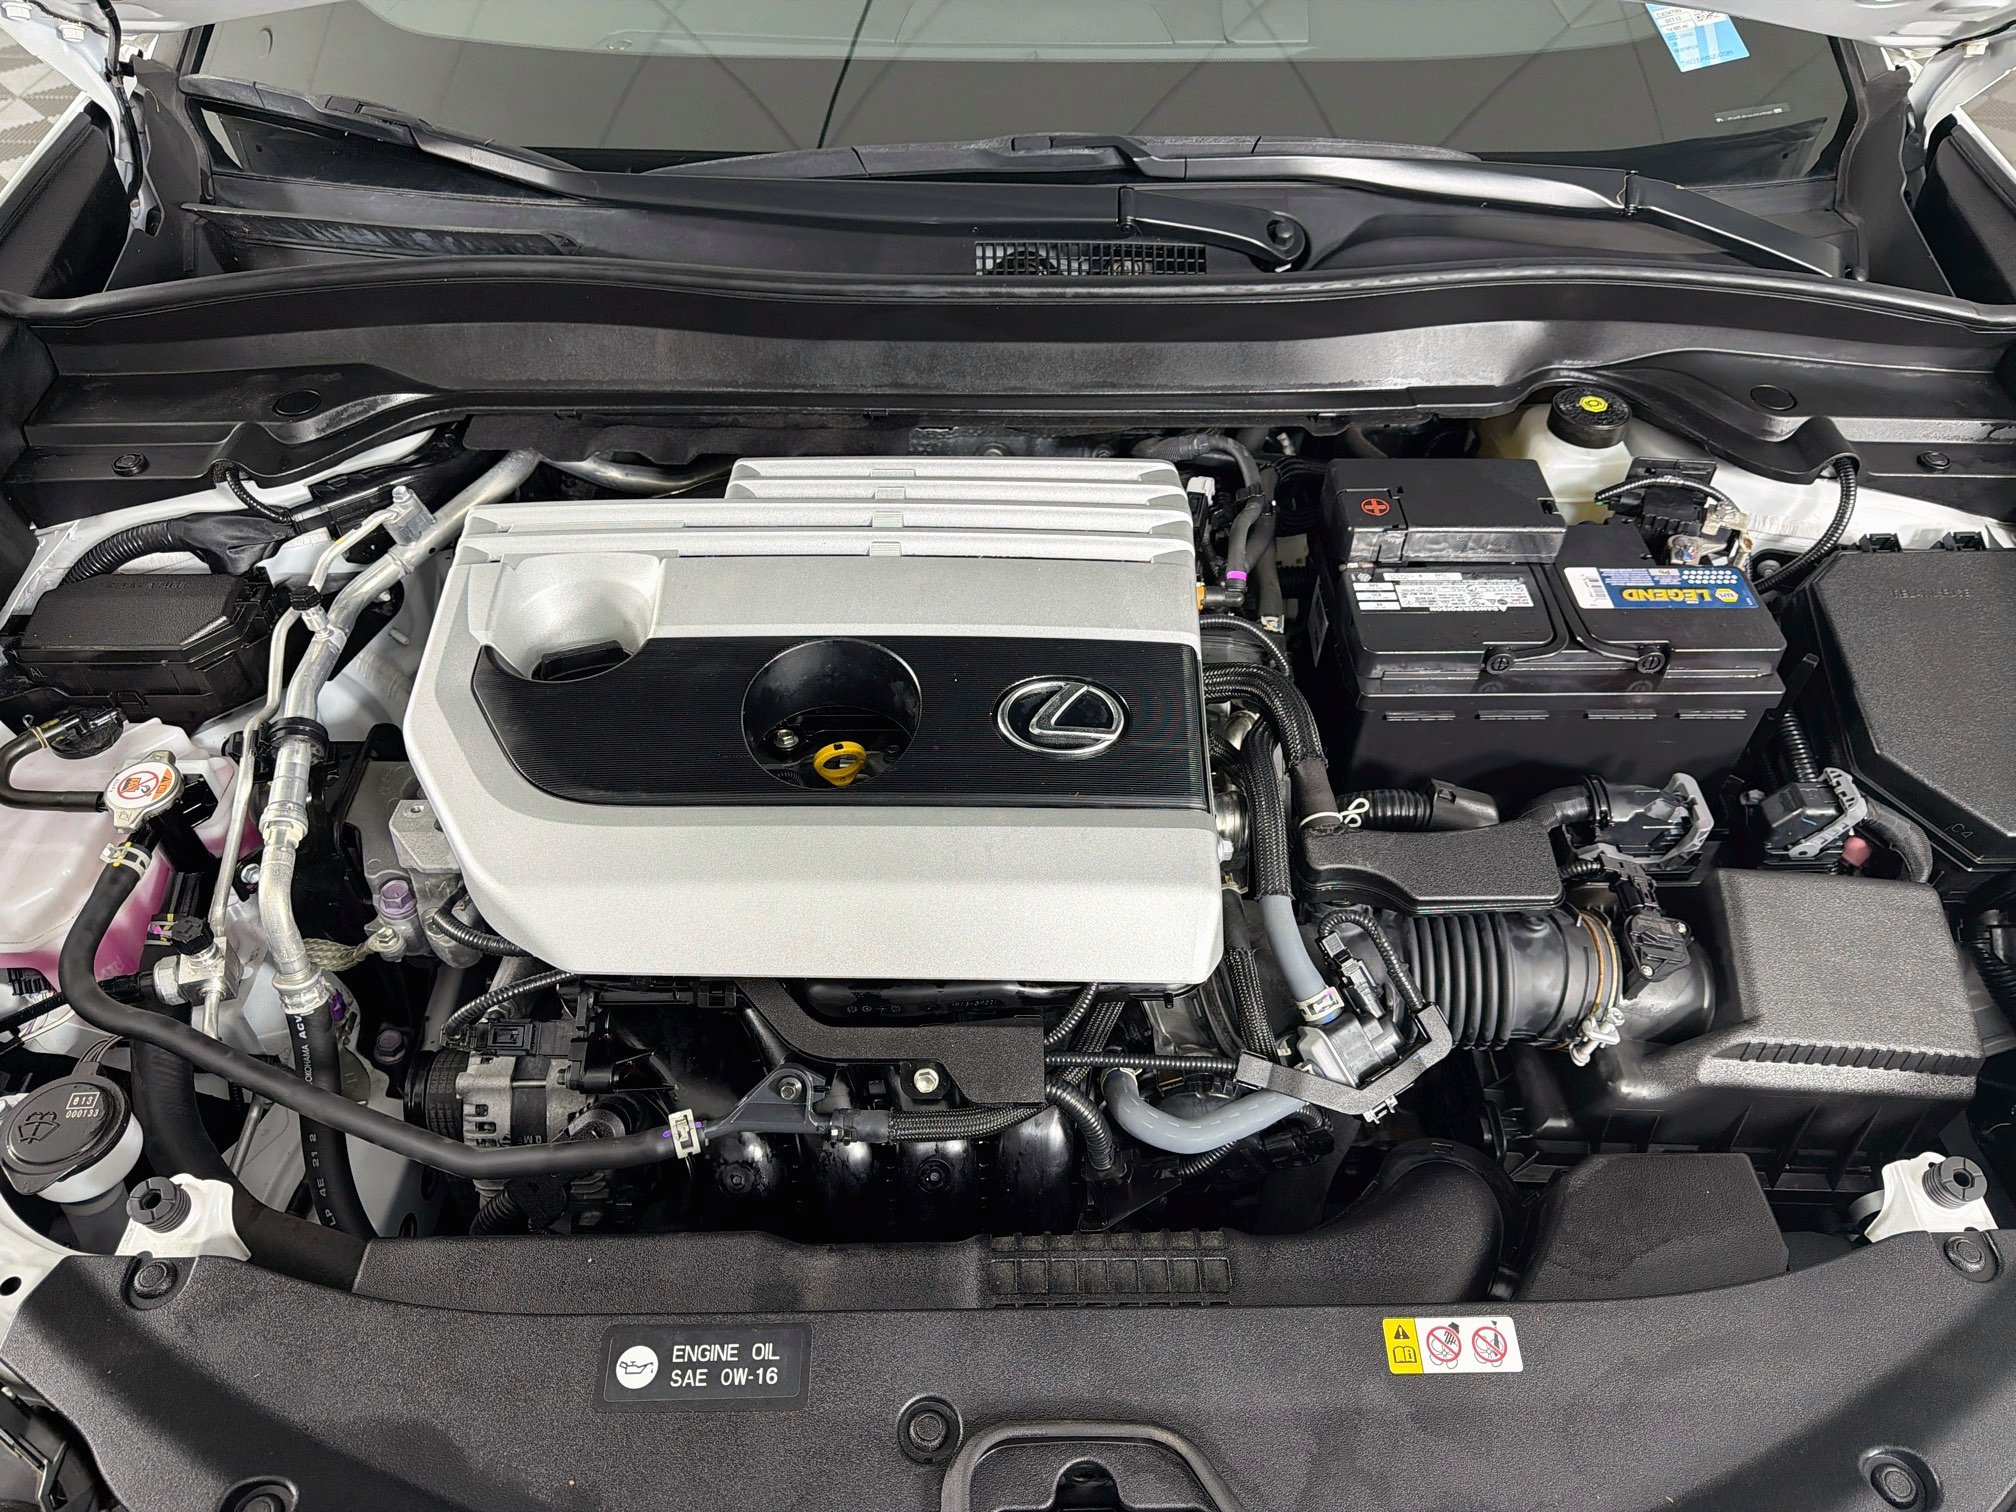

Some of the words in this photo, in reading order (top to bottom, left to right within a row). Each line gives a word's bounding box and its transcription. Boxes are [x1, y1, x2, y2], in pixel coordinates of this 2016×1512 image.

[1622, 588, 1712, 602] LEGEND
[301, 1044, 313, 1085] OKOHAMA
[65, 1109, 99, 1118] 000133
[324, 1208, 337, 1227] LP
[672, 1343, 740, 1363] ENGINE
[752, 1343, 781, 1361] OIL
[670, 1368, 709, 1388] SAE
[720, 1367, 778, 1386] 0W-16
